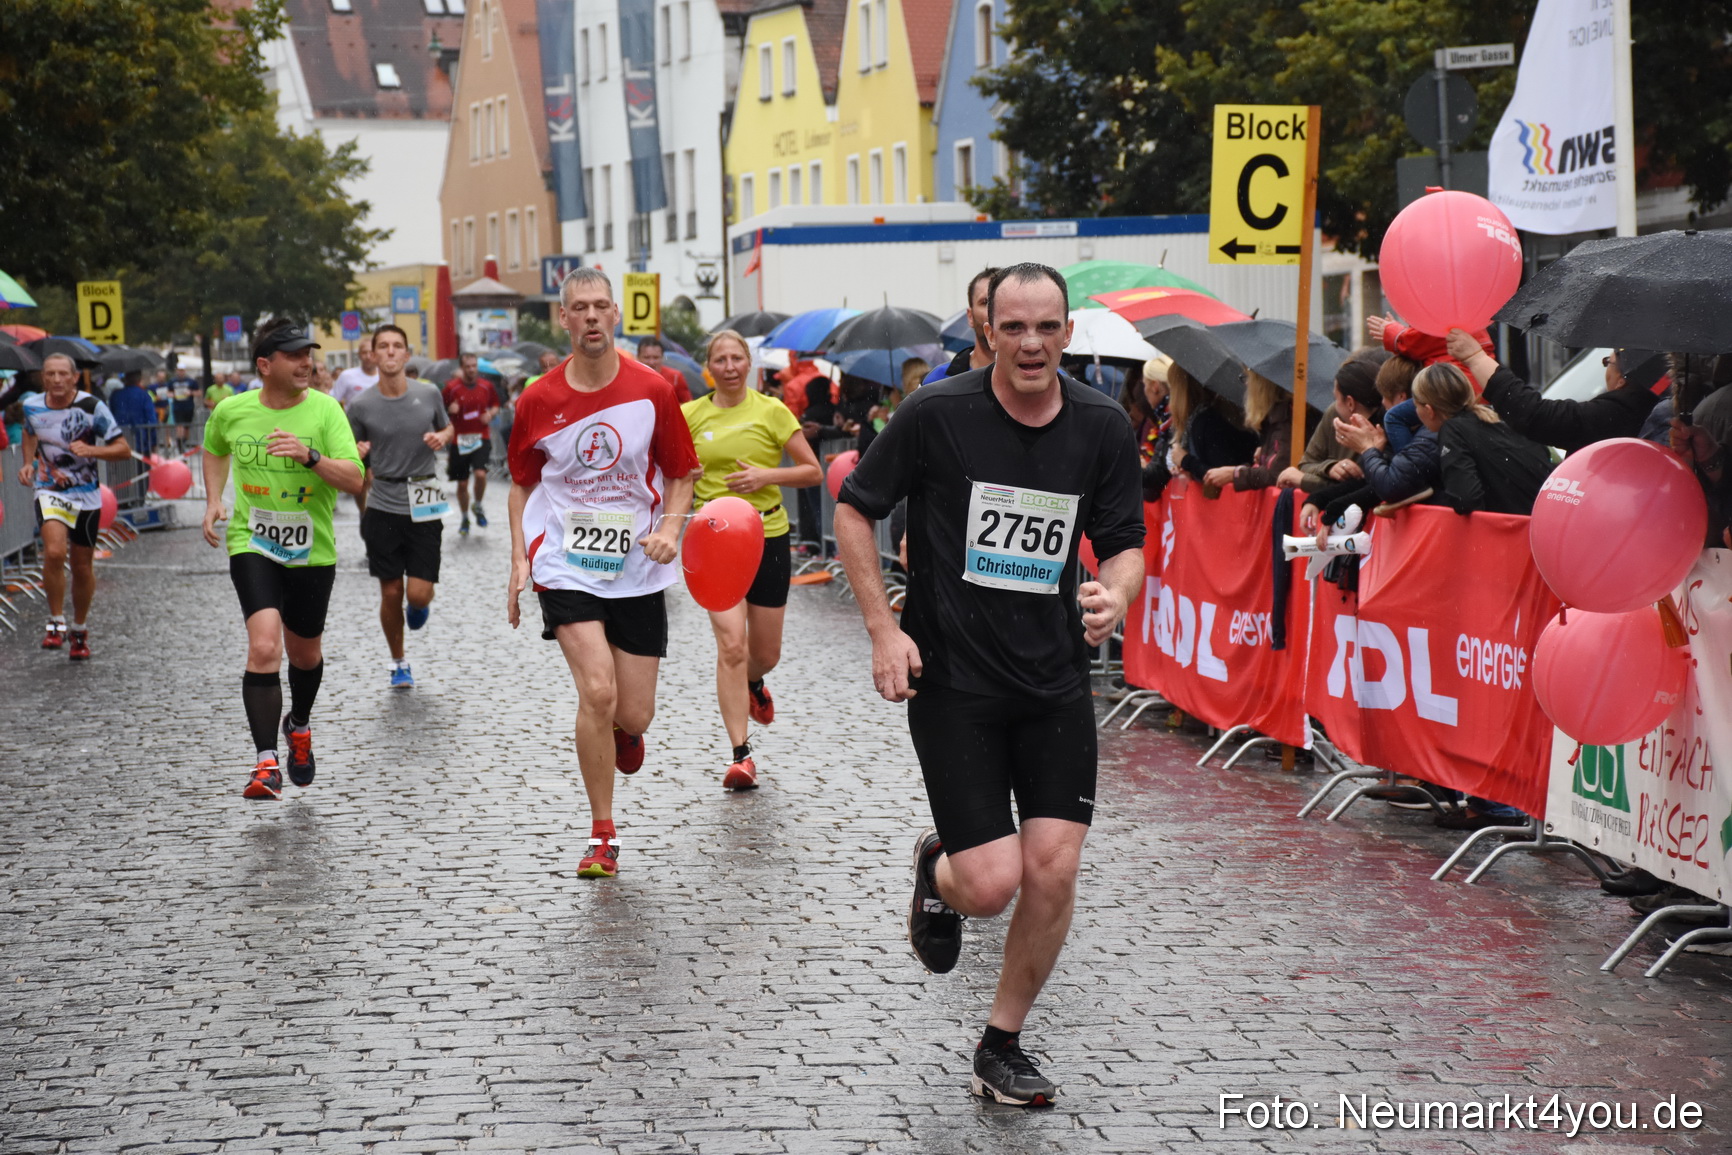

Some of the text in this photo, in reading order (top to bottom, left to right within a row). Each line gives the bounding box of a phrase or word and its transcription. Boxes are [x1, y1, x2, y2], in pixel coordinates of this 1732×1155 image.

[1450, 49, 1510, 64] Ulmer Gasse
[623, 57, 656, 129] K&L
[545, 72, 576, 142] K&L
[1227, 113, 1307, 140] Block
[1237, 153, 1290, 231] C
[83, 284, 116, 297] Block
[627, 276, 656, 288] Block
[90, 302, 112, 330] D
[633, 292, 651, 320] D
[980, 494, 1015, 504] NeuerMarkt
[1021, 492, 1071, 511] BOCK
[255, 522, 308, 547] 2920
[572, 526, 631, 554] 2226
[977, 509, 1066, 556] 2756
[270, 545, 294, 560] Klaus
[581, 557, 620, 571] Rüdiger
[977, 556, 1053, 581] Christopher
